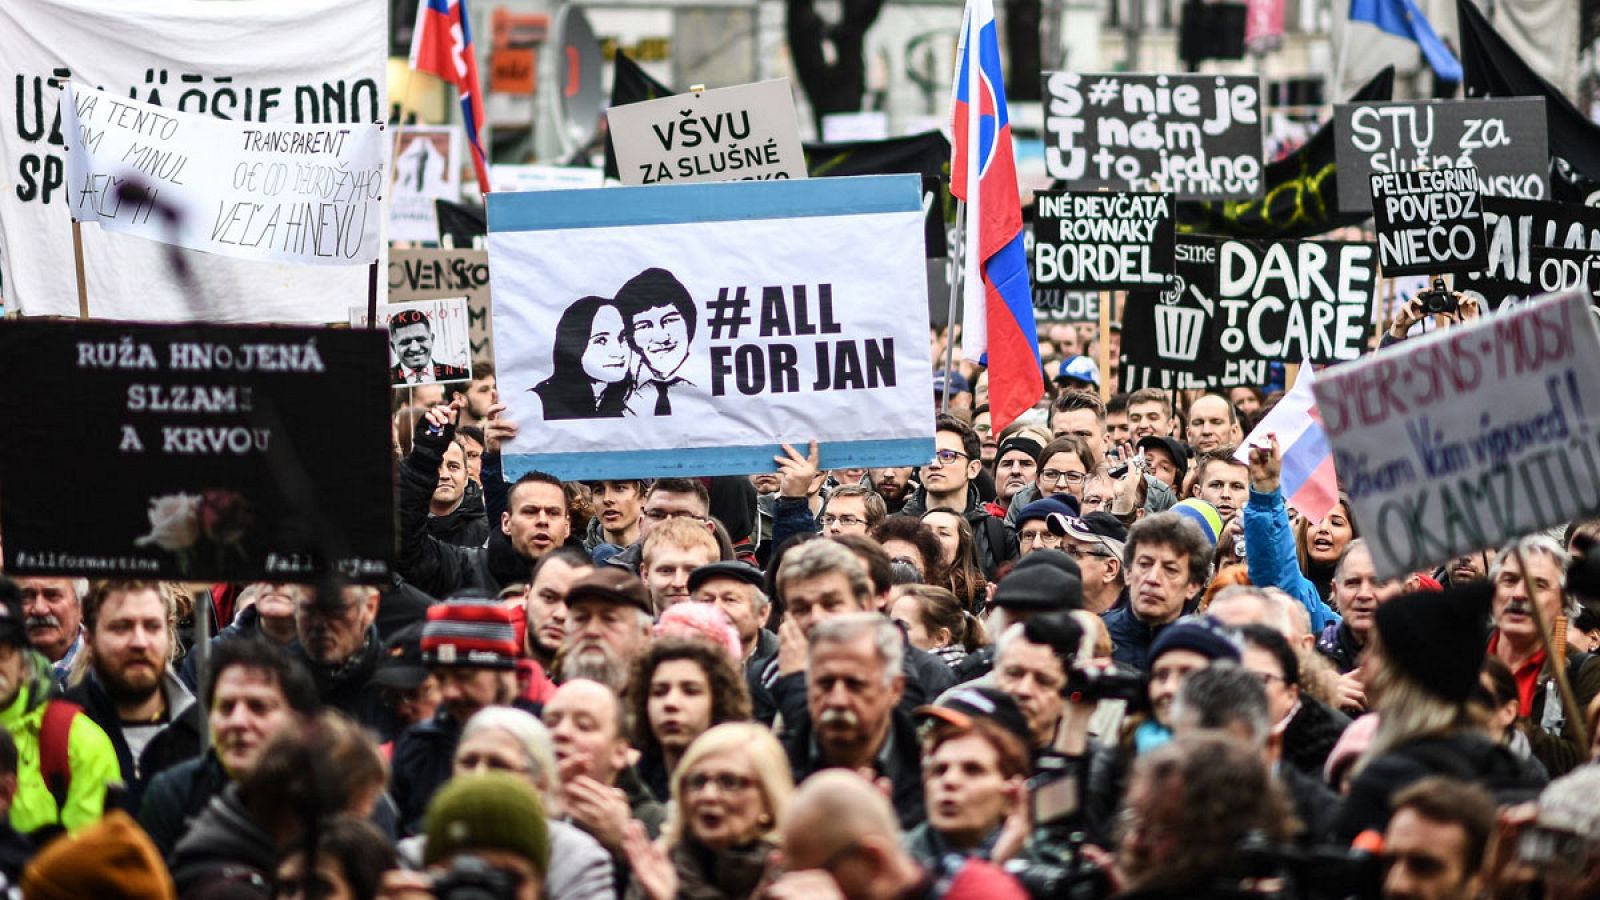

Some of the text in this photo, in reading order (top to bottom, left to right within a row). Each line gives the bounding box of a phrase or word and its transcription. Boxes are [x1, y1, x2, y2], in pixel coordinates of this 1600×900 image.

[1203, 76, 1258, 135] je
[108, 100, 180, 142] TENTO
[243, 129, 351, 158] TRANSPARENT
[652, 109, 751, 152] VŠVU
[1097, 112, 1202, 151] nám
[1351, 105, 1512, 153] STU za
[121, 141, 189, 186] MINUL
[639, 138, 781, 185] ZA SLUŠNÉ
[1092, 147, 1261, 184] to jedno
[1370, 167, 1480, 198] PELLEGRINI
[1038, 192, 1073, 218] INÉ
[1385, 191, 1480, 224] POVEDZ
[1059, 216, 1158, 243] ROVNAKÝ
[1378, 218, 1477, 267] NIEČO
[1035, 242, 1174, 285] BORDEL.
[1219, 241, 1372, 304] DARE
[706, 283, 842, 340] #ALL
[1247, 295, 1366, 361] CARE
[76, 335, 325, 372] RUŽA HNOJENÁ
[709, 337, 897, 396] FOR JAN
[119, 425, 271, 453] A KRVOU
